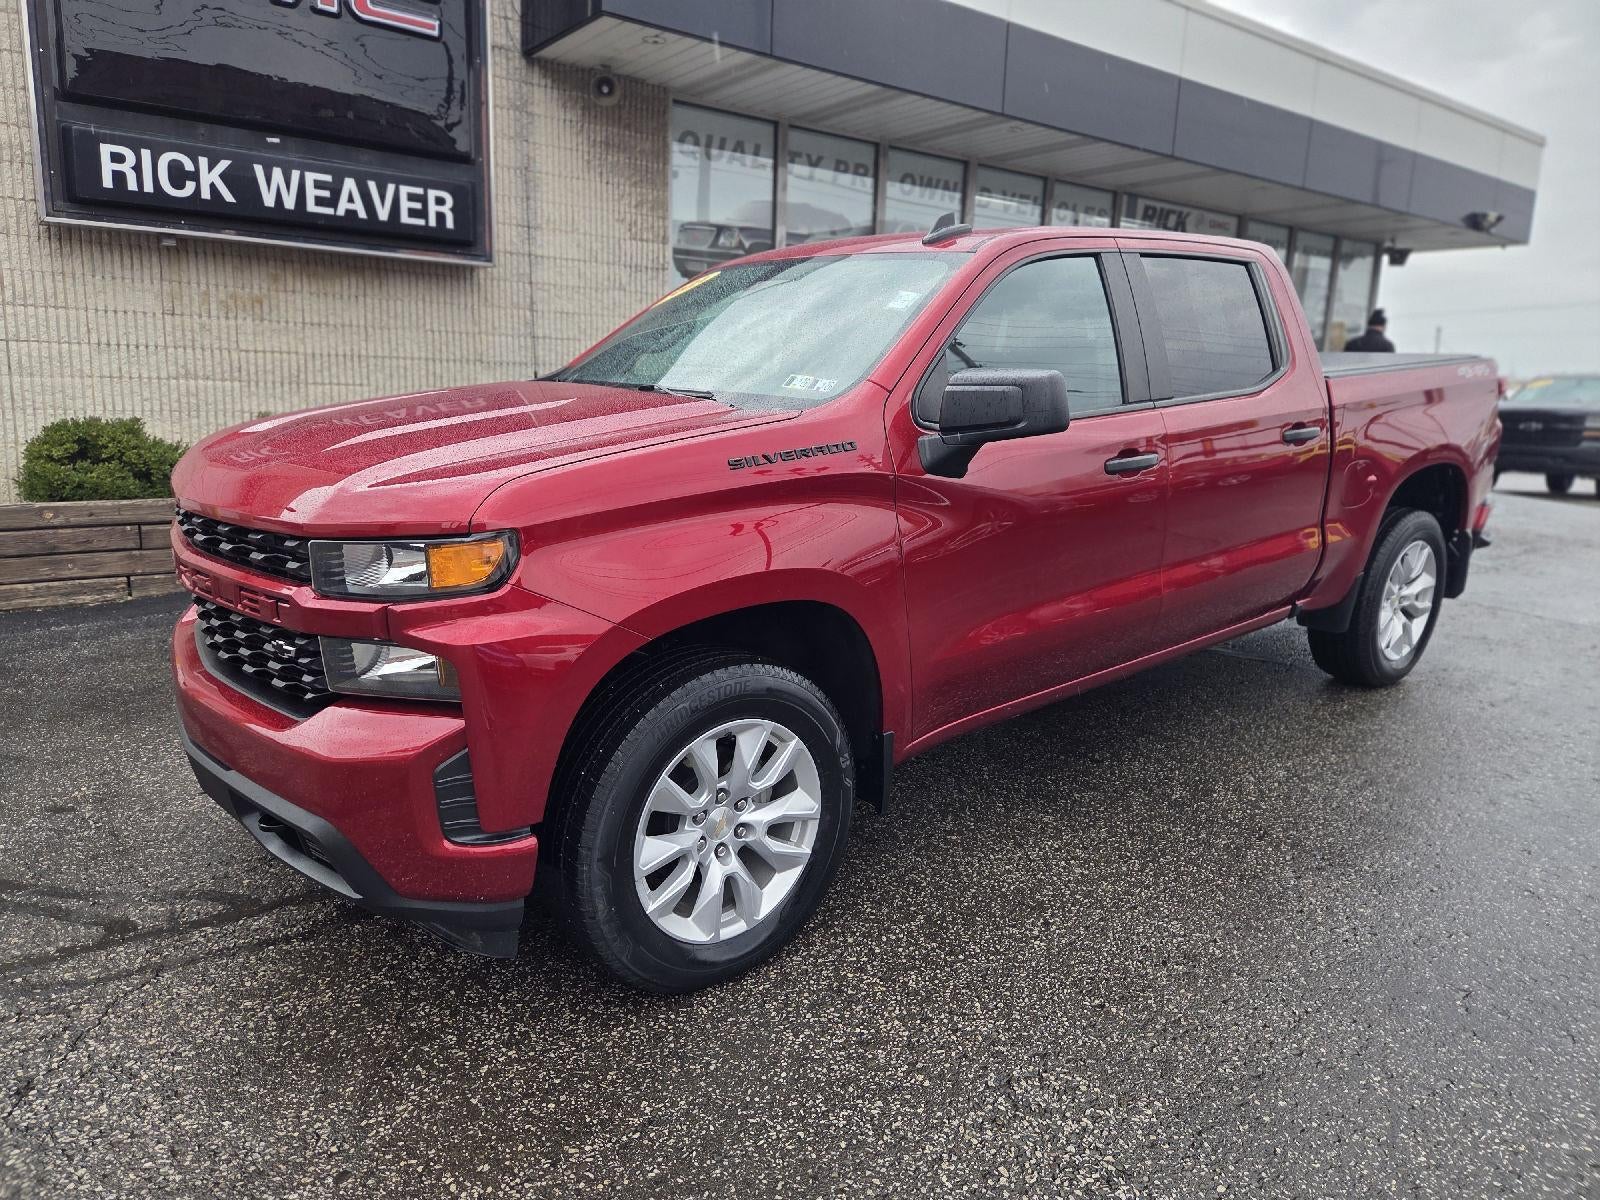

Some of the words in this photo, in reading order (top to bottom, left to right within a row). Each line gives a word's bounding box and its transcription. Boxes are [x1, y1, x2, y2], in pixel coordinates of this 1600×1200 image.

[99, 143, 237, 204] RICK
[253, 163, 455, 230] WEAVER
[677, 130, 825, 181] QUALTY
[1001, 190, 1109, 228] VEHCLES
[1140, 204, 1191, 232] RICK
[728, 440, 857, 470] SILVERADO
